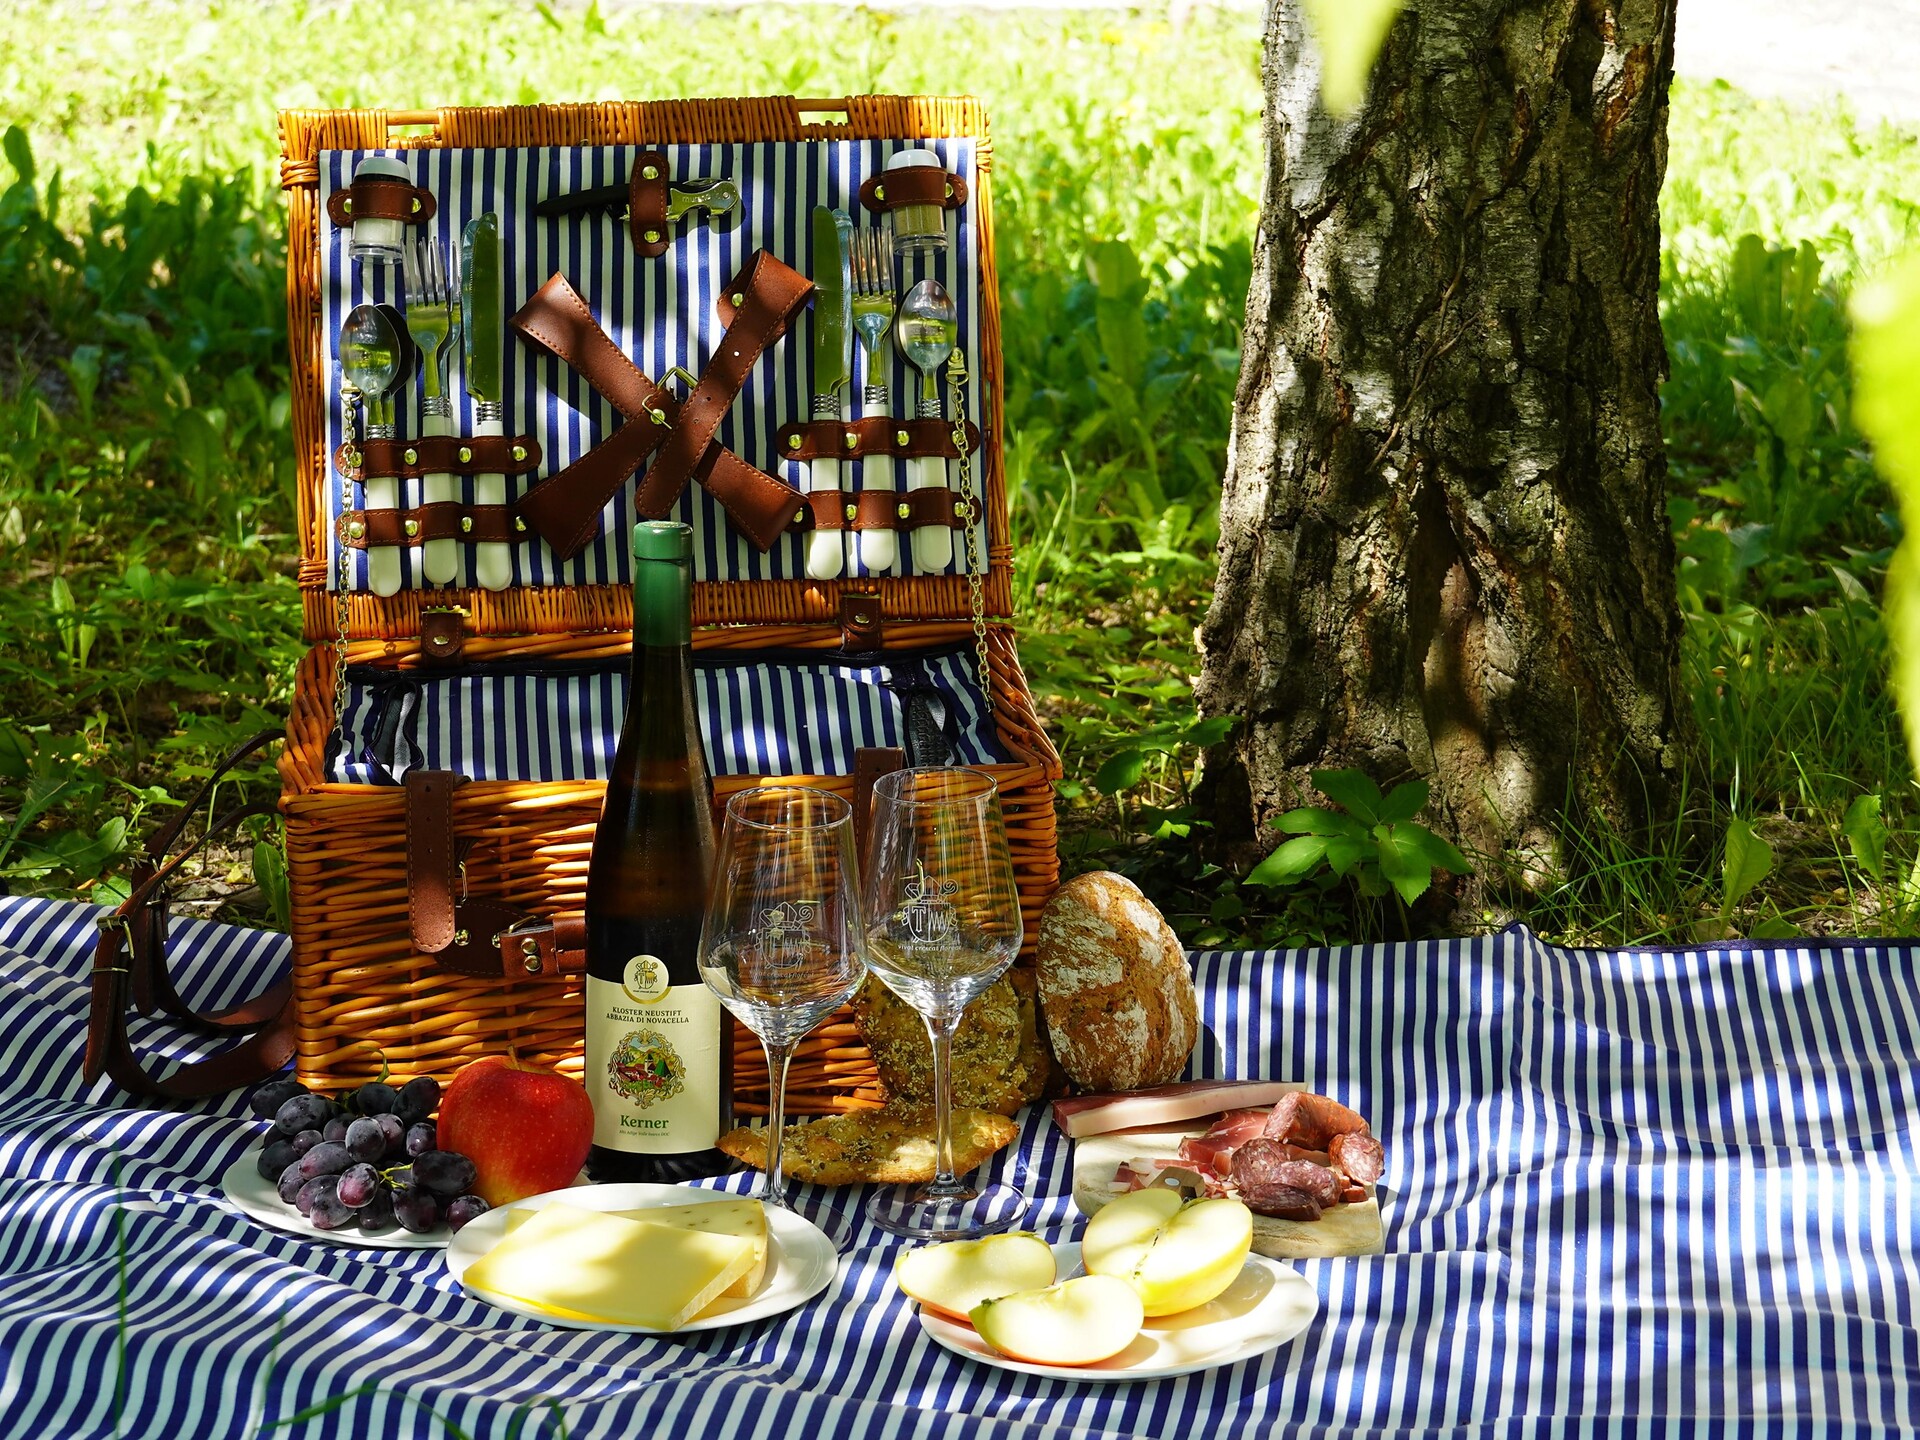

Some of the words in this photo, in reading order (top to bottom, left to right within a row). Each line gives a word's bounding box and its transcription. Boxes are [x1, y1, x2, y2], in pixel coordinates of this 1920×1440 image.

[612, 1006, 643, 1016] KLOSTER
[606, 1013, 634, 1023] ABBAZIA
[646, 1016, 690, 1024] NOVACELLA
[620, 1114, 669, 1129] Kerner
